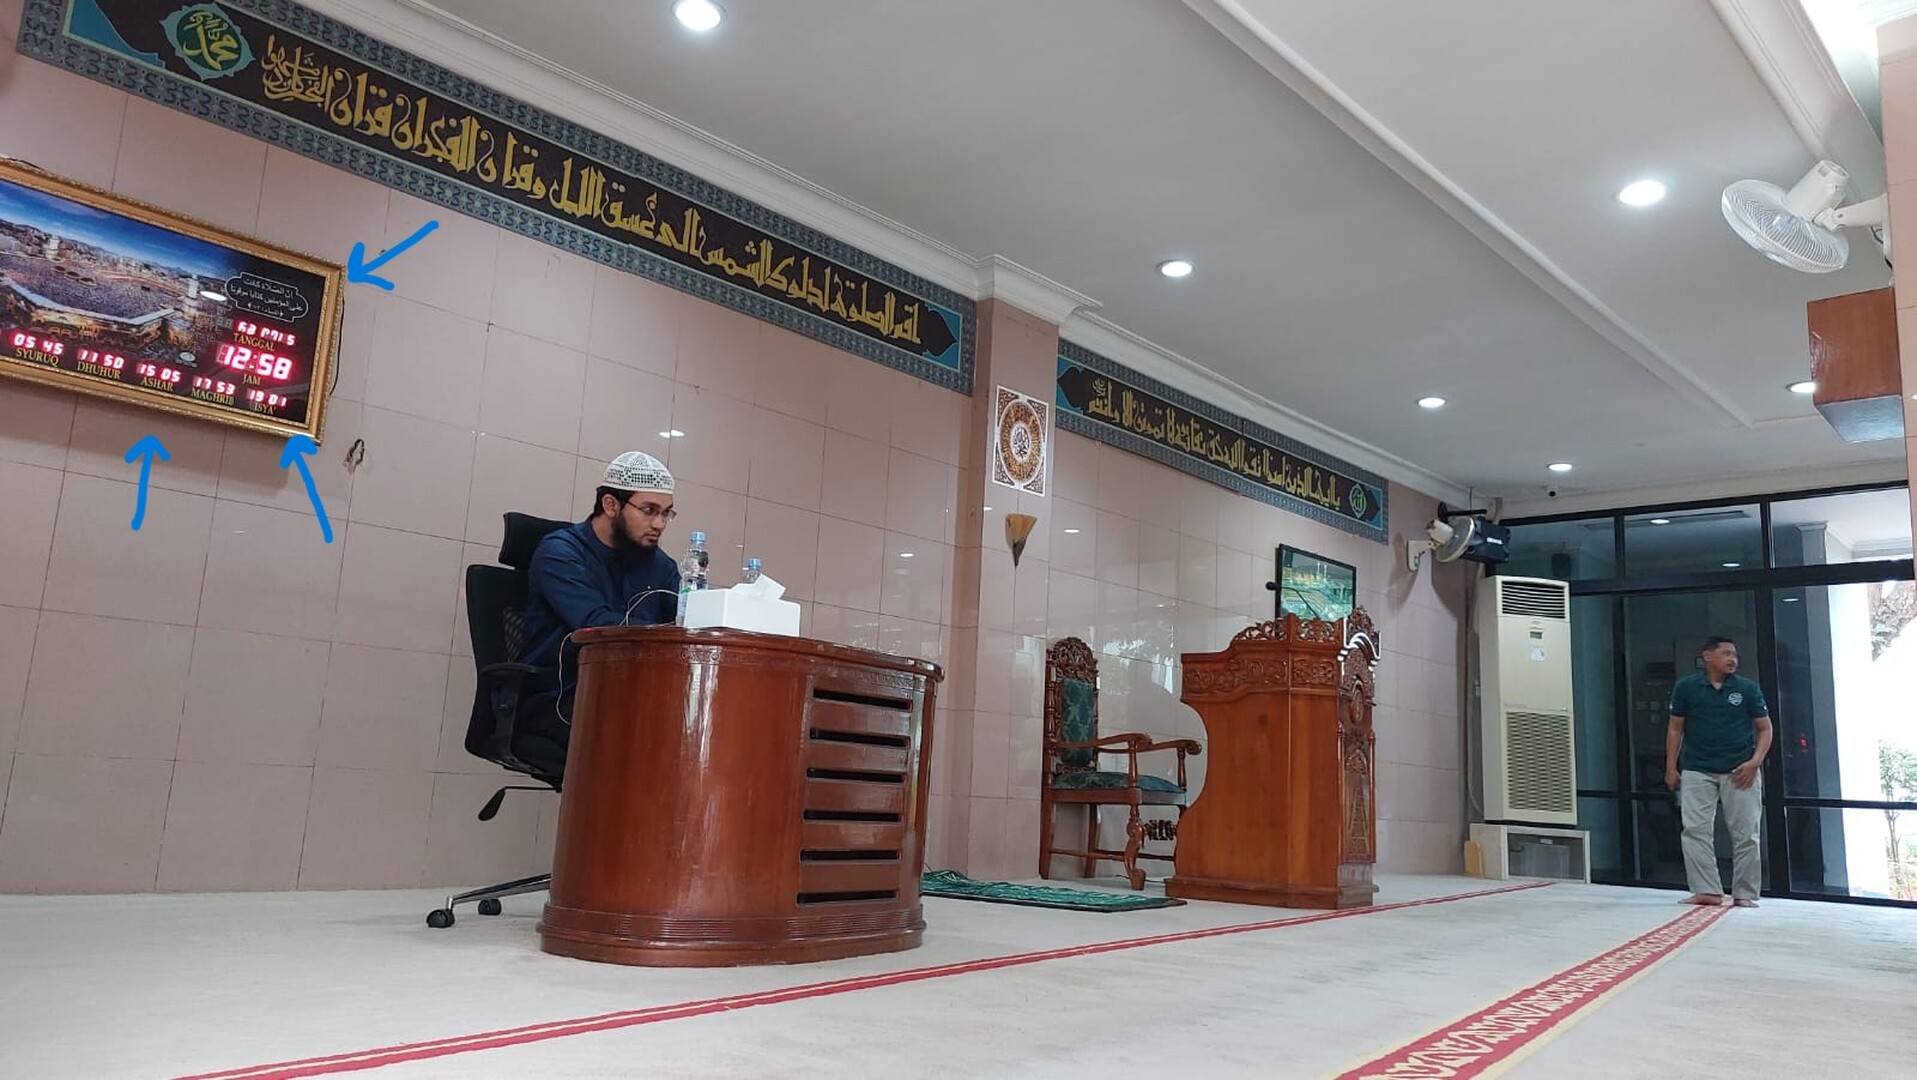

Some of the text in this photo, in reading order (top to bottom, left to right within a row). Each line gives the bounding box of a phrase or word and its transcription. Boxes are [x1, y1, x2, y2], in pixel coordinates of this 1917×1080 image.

[14, 333, 65, 355] 05 45
[233, 332, 276, 351] TANGGAL
[15, 347, 59, 368] SYURUQ
[81, 350, 125, 369] 11 50
[223, 346, 293, 381] 12:58
[77, 361, 121, 380] DHUHUR
[140, 363, 181, 383] 15 05
[242, 373, 261, 386] JAM
[140, 377, 174, 392] ASHAR
[194, 376, 236, 395] 17 53
[191, 387, 234, 405] MAGHRIB
[249, 389, 287, 408] 19 01
